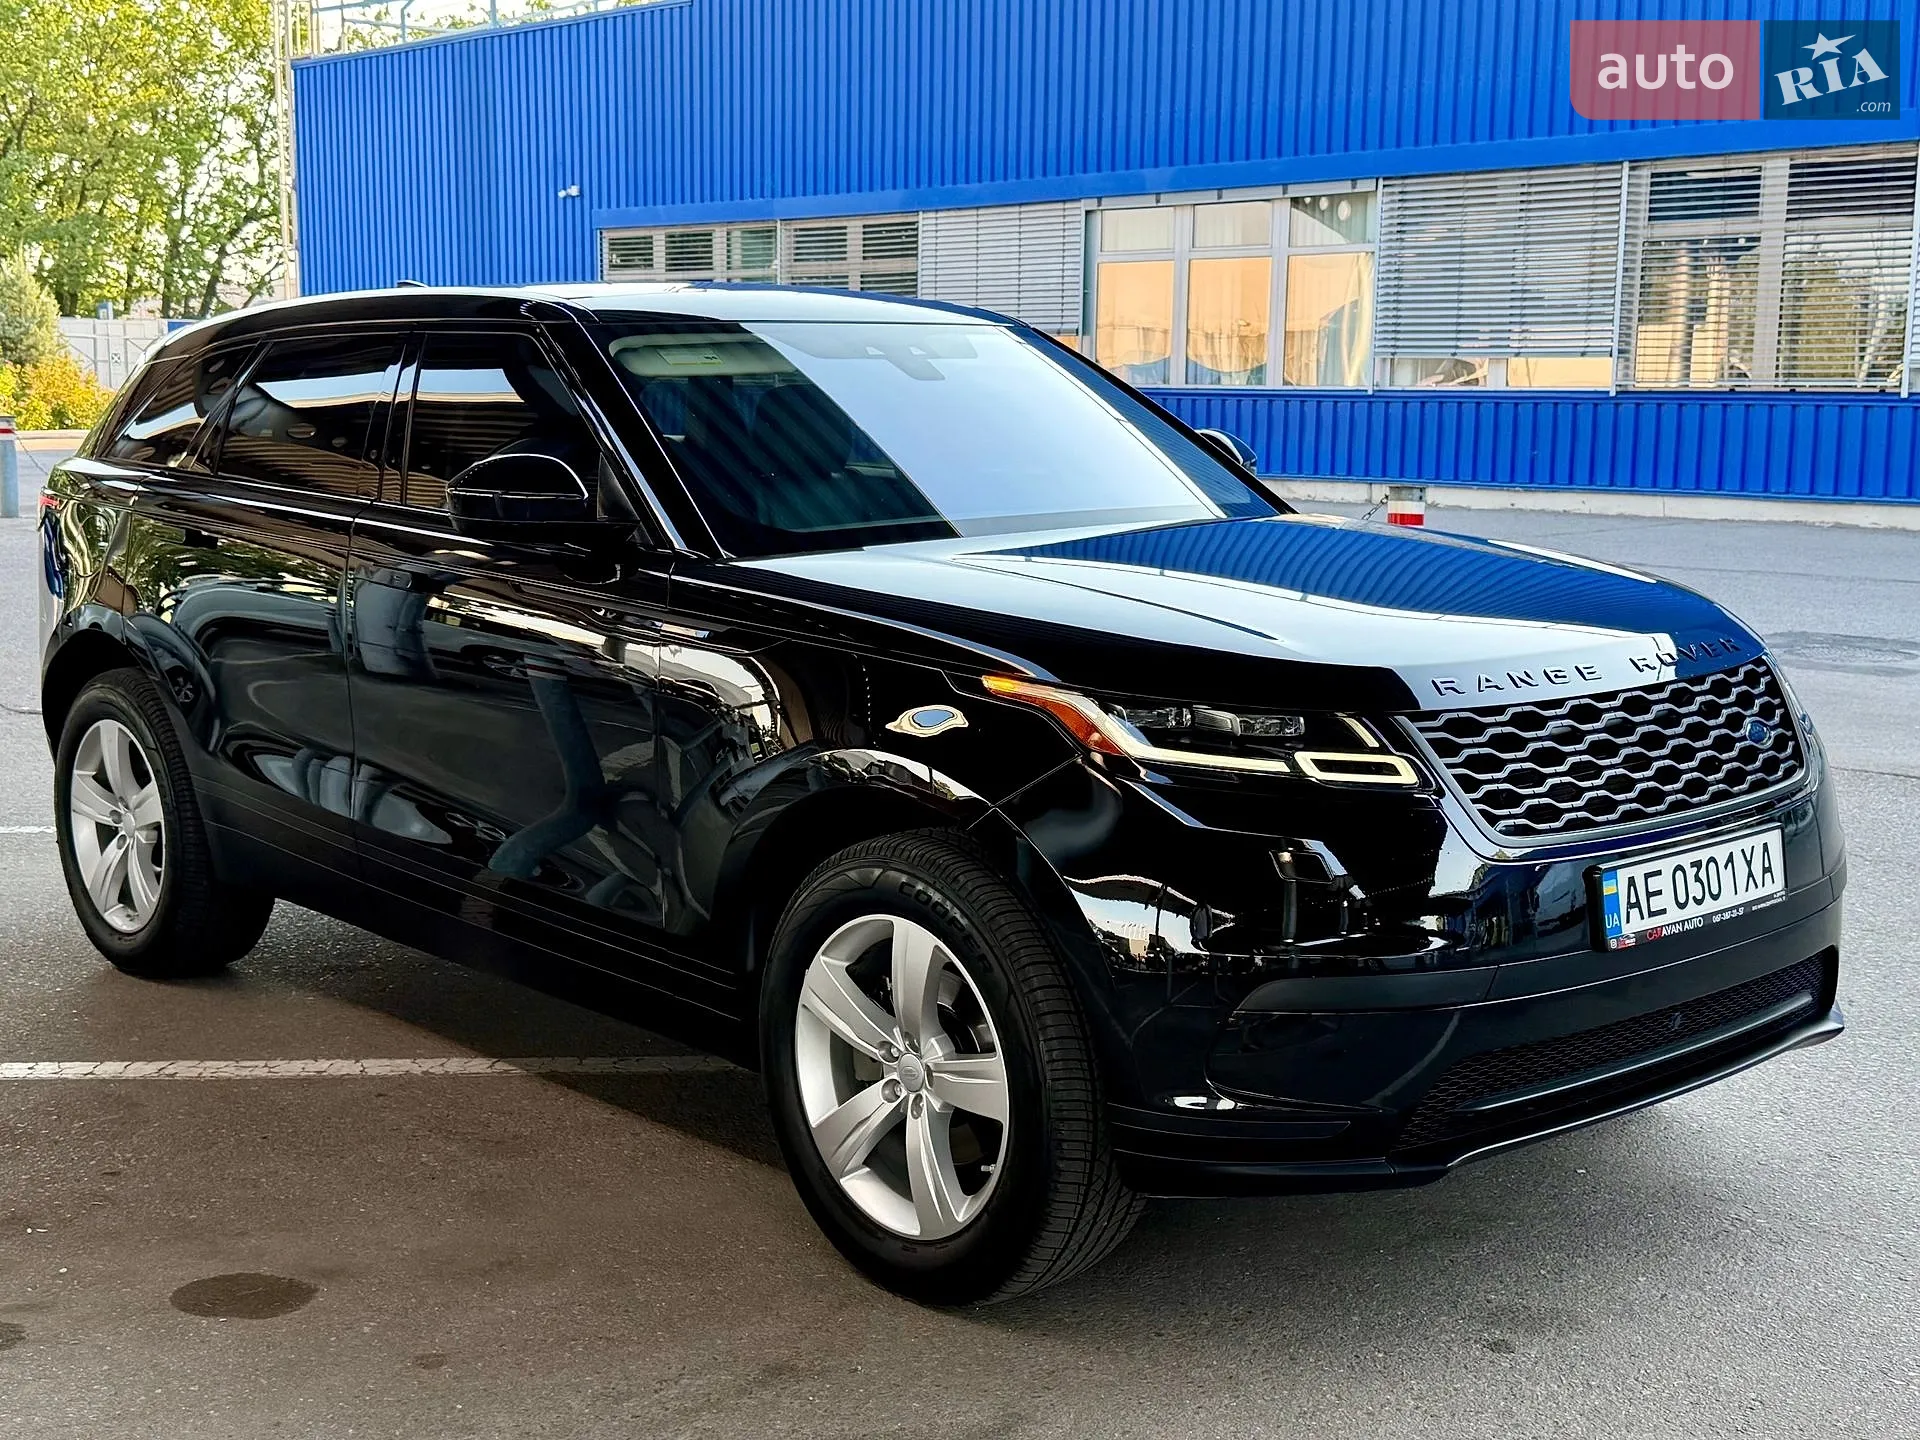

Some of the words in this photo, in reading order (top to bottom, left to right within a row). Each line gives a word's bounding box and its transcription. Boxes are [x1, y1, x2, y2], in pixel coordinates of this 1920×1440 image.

[1431, 664, 1602, 697] RANGE
[1628, 638, 1741, 673] ROVER
[1625, 869, 1668, 925] AE
[1605, 912, 1620, 929] UA
[1683, 917, 1704, 932] AUTO
